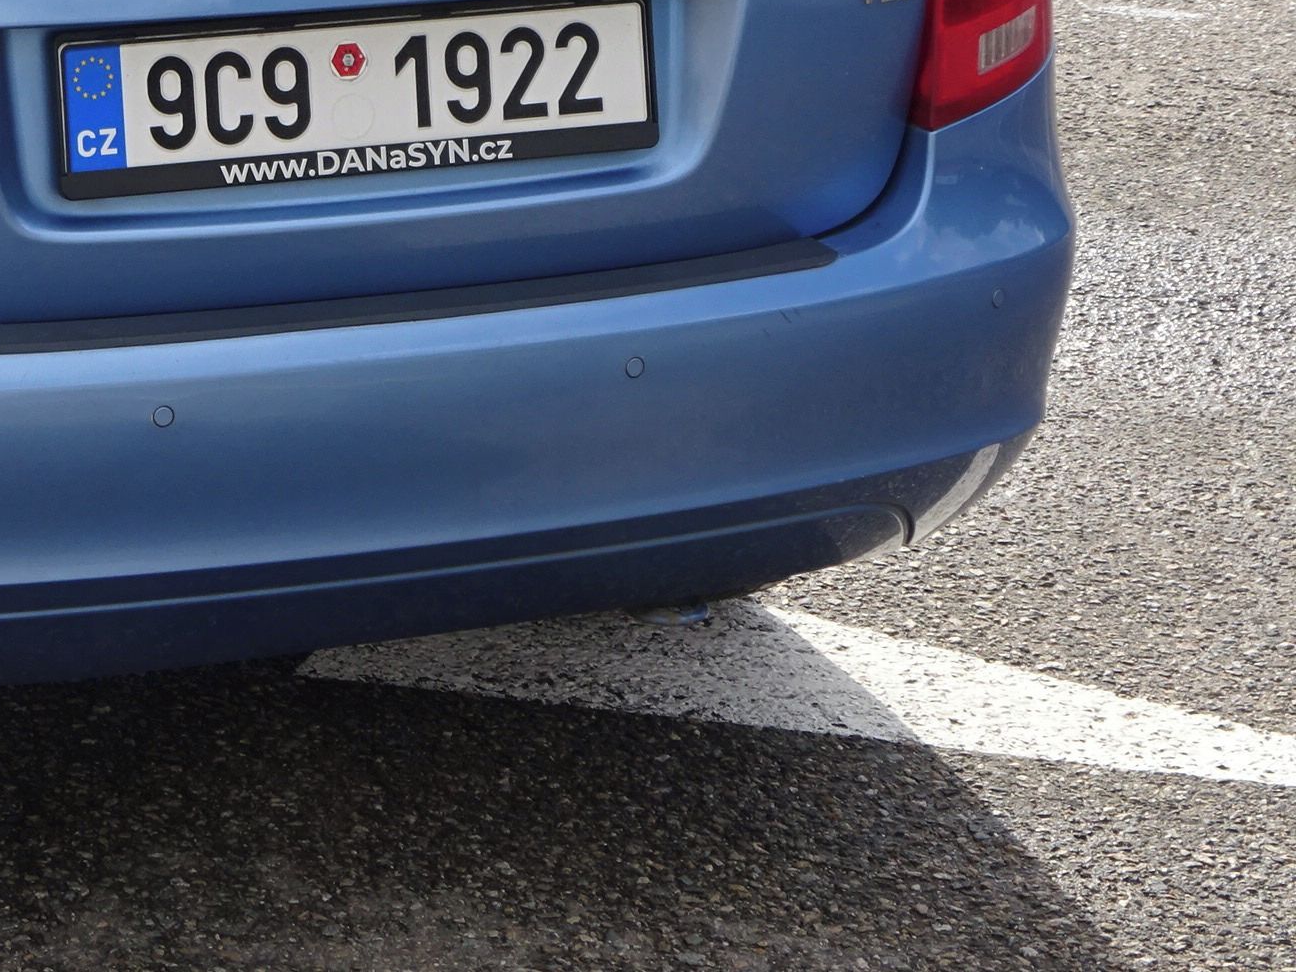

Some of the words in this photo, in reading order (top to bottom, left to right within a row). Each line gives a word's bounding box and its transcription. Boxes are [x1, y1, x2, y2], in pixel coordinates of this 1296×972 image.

[146, 46, 312, 151] 9C9
[394, 21, 604, 128] 1922
[77, 127, 118, 159] CZ
[220, 138, 514, 185] www.DANaSYN.cz
